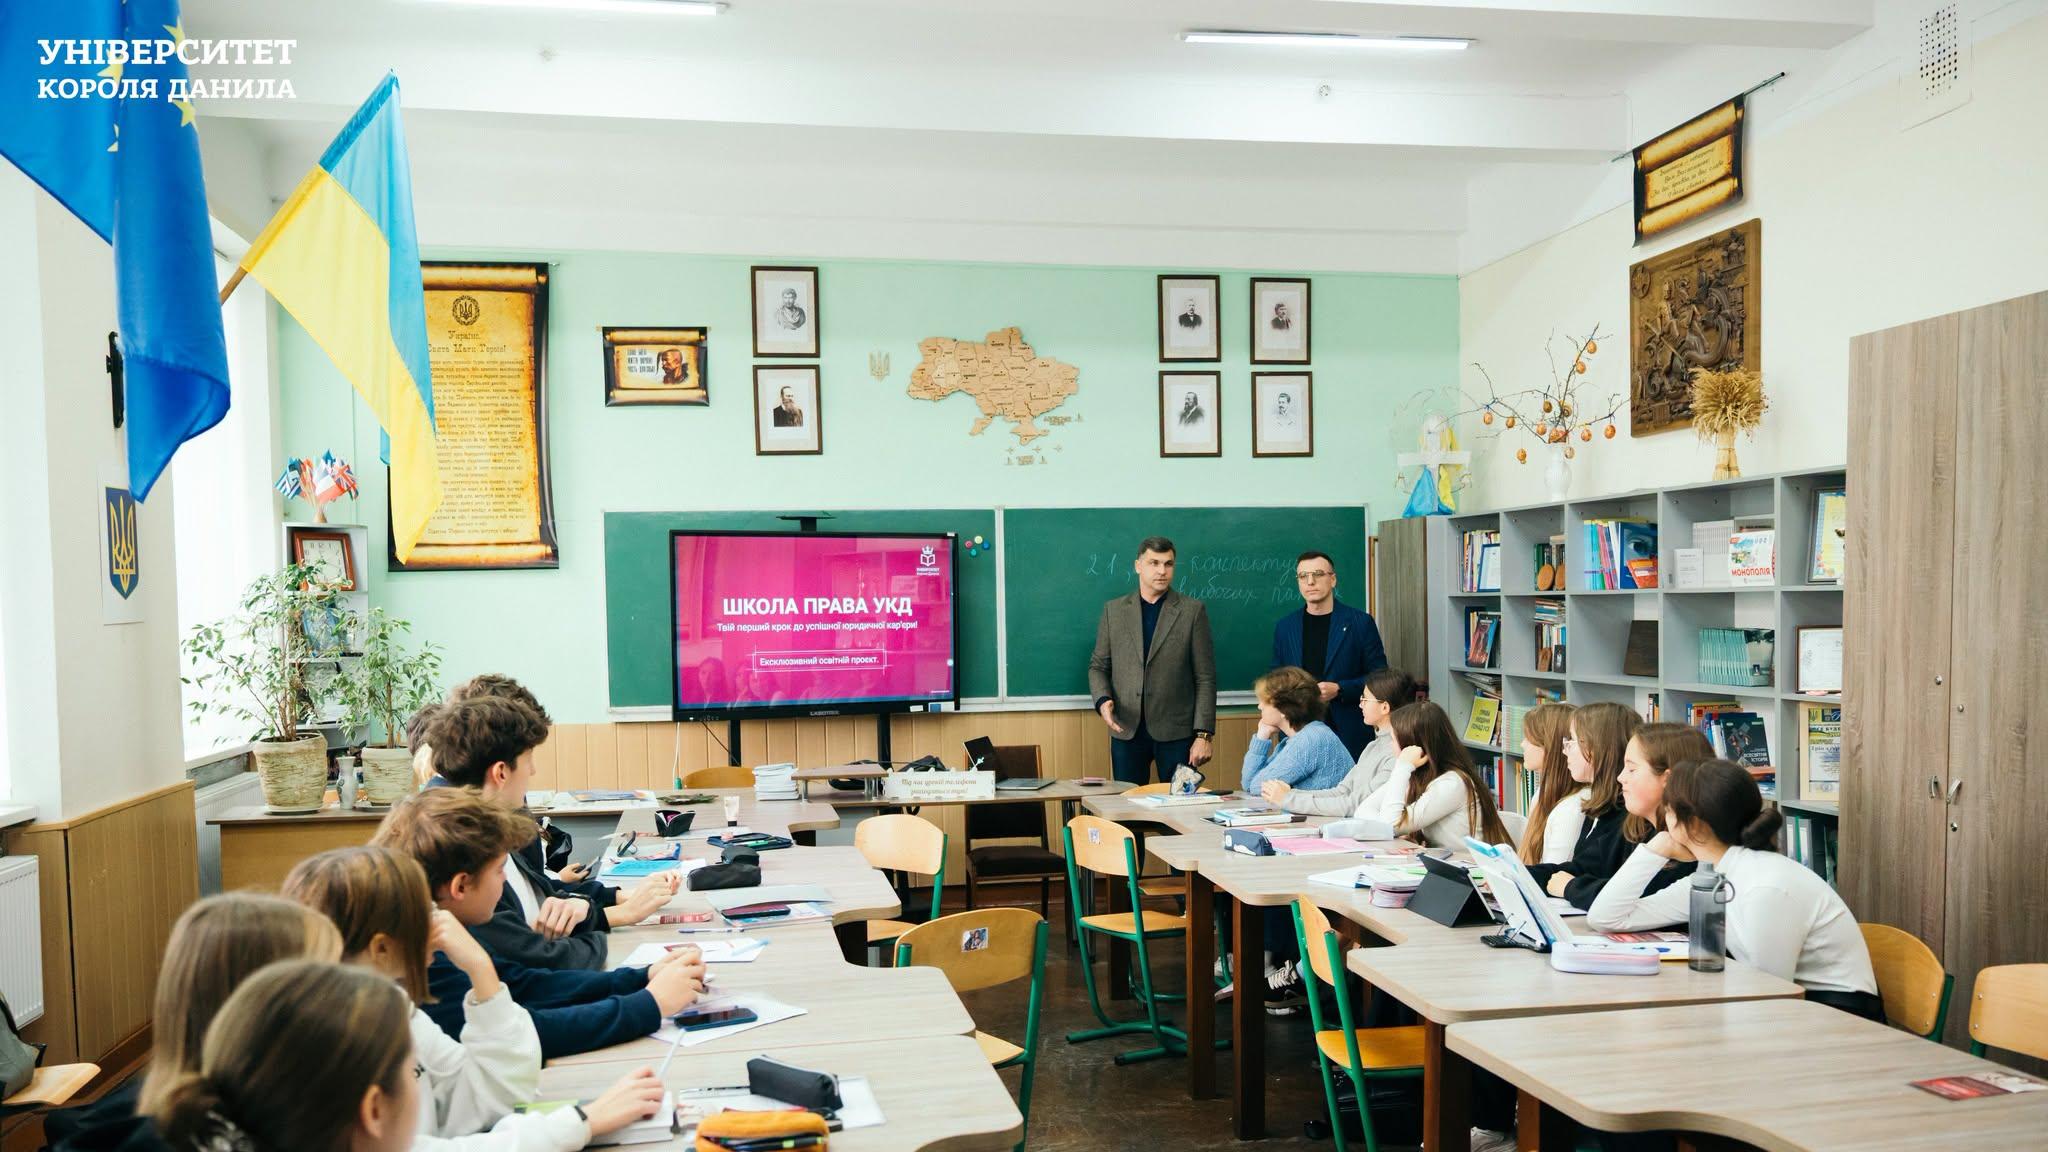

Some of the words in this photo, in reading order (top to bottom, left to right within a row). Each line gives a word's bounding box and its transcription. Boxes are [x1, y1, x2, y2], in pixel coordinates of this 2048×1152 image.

[1731, 567, 1771, 577] МОНОПОЛІЯ
[723, 597, 799, 616] ШКОЛА
[804, 597, 868, 615] ПРАВА
[872, 597, 913, 616] УКД
[717, 622, 736, 632] Твій
[737, 622, 770, 633] перший
[772, 623, 792, 633] крок
[793, 623, 804, 632] до
[805, 622, 842, 633] успішної
[842, 621, 886, 633] юридичної
[886, 621, 918, 632] кар'єри!
[759, 657, 817, 667] Ексклюзивний
[819, 656, 850, 665] освітній
